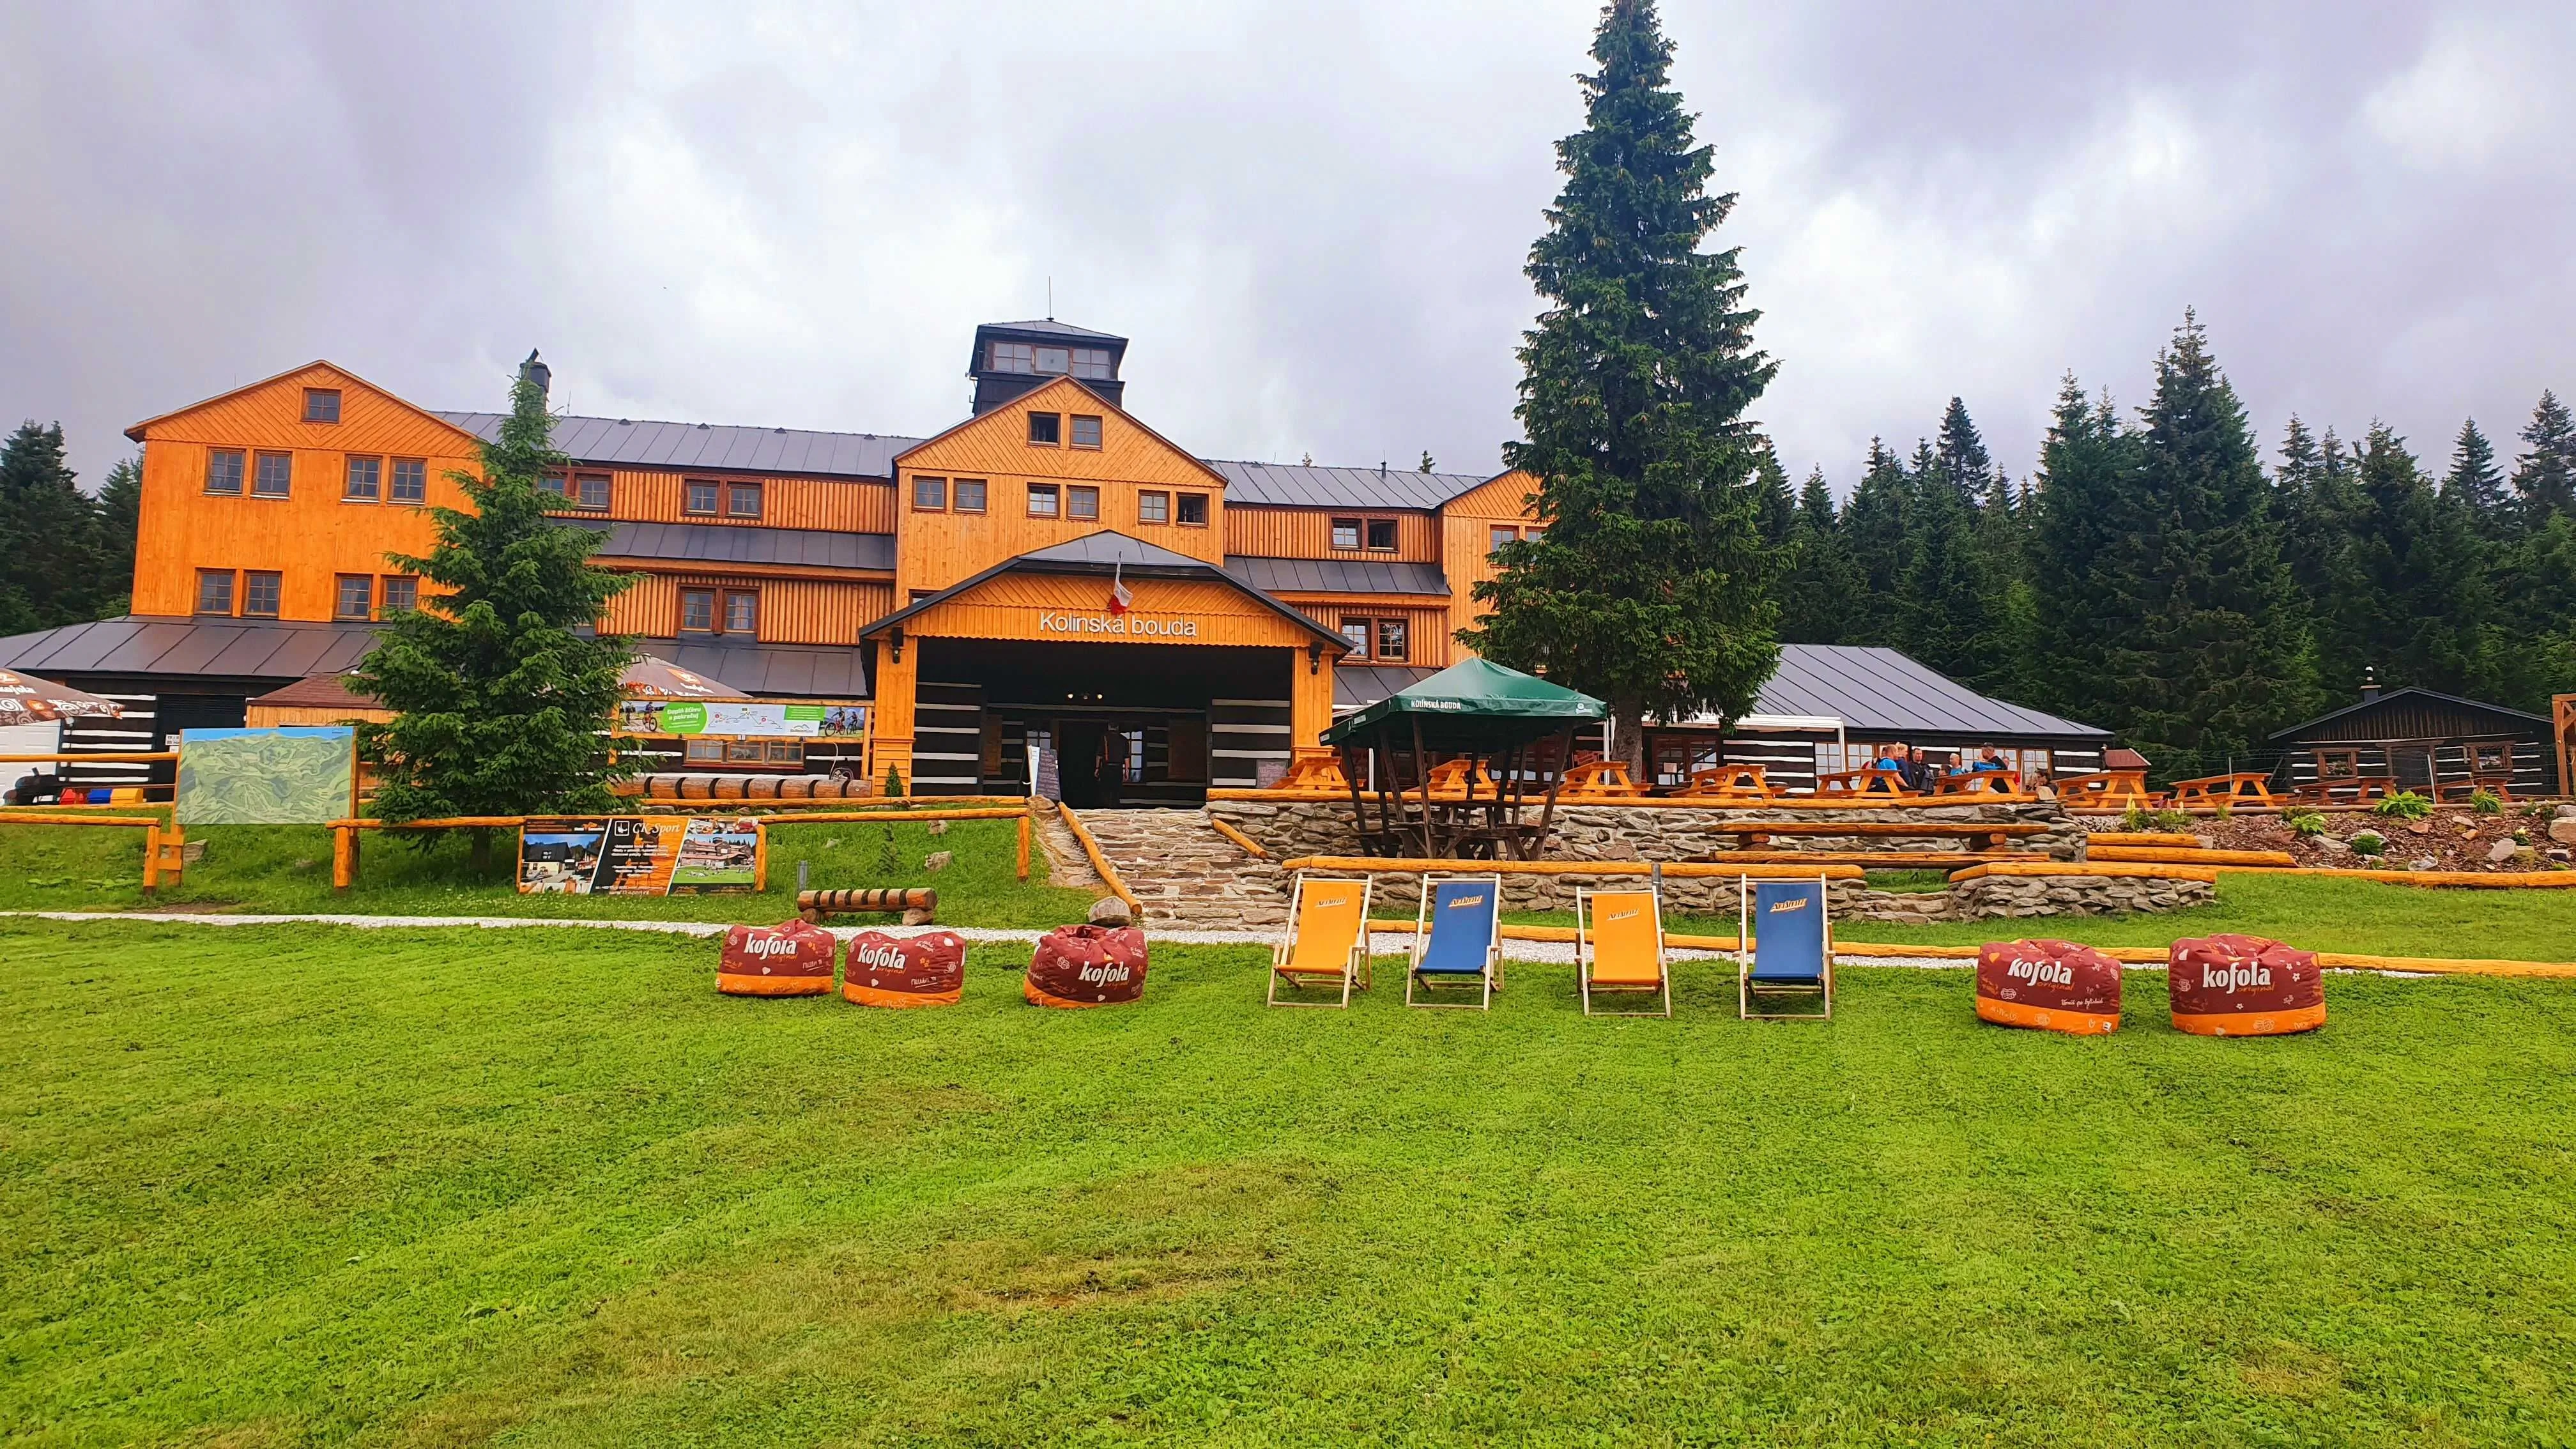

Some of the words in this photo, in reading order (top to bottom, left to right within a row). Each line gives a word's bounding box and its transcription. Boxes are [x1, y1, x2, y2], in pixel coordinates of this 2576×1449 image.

[1039, 611, 1126, 634] Kolínská
[1131, 615, 1197, 637] bouda
[1411, 699, 1438, 709] KOLÍNSKÁ
[1439, 701, 1462, 710] BOUDA
[744, 933, 797, 960] kofola
[857, 942, 906, 971] kofola
[876, 967, 907, 976] original
[1078, 960, 1130, 988] kofola
[2007, 958, 2072, 986] kofola
[2202, 961, 2271, 994] kofola
[2037, 981, 2075, 993] original
[2236, 981, 2275, 997] original
